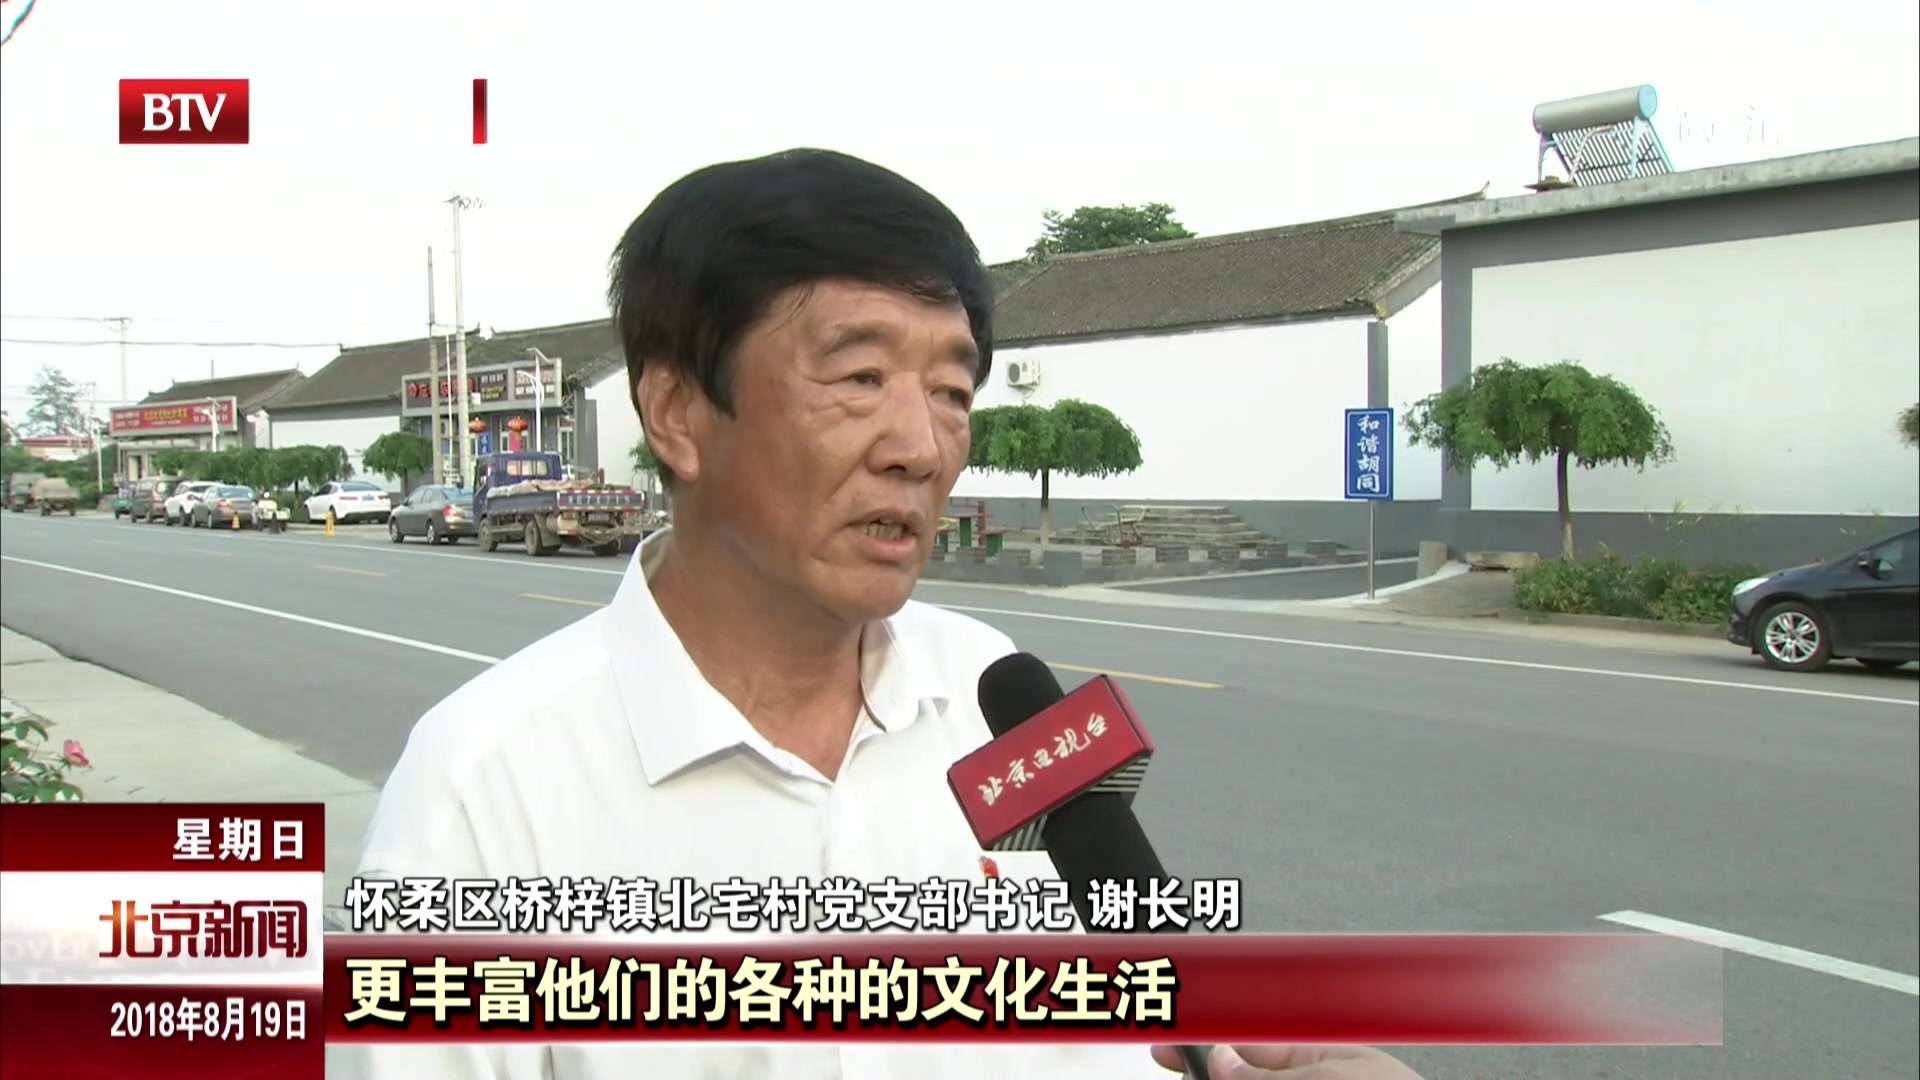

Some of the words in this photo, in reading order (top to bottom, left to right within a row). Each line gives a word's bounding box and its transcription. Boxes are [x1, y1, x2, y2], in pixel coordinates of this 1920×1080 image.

[1356, 414, 1380, 493] 和谐胡同
[978, 712, 1108, 806] 北京电视台
